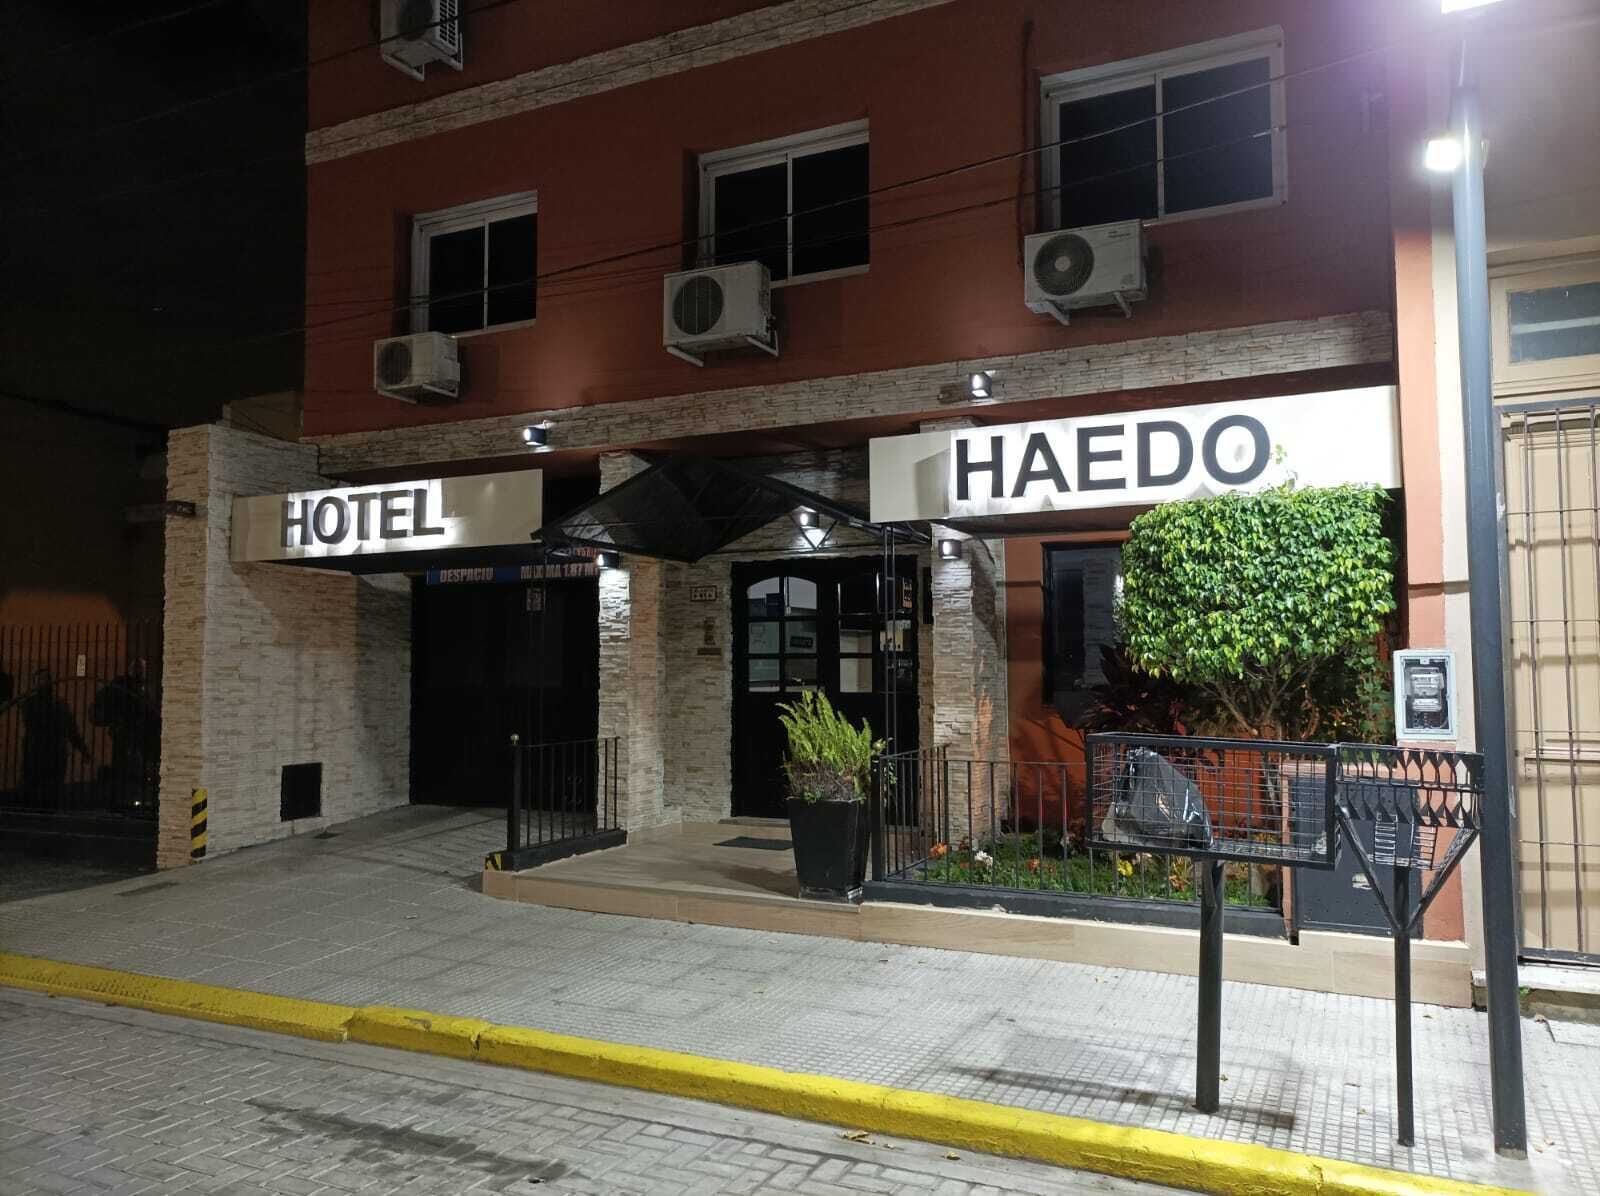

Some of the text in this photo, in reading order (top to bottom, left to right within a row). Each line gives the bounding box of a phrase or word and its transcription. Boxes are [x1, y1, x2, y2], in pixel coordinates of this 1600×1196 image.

[955, 414, 1271, 500] HAEDO
[280, 488, 445, 547] HOTEL
[440, 567, 494, 582] DESPACIO
